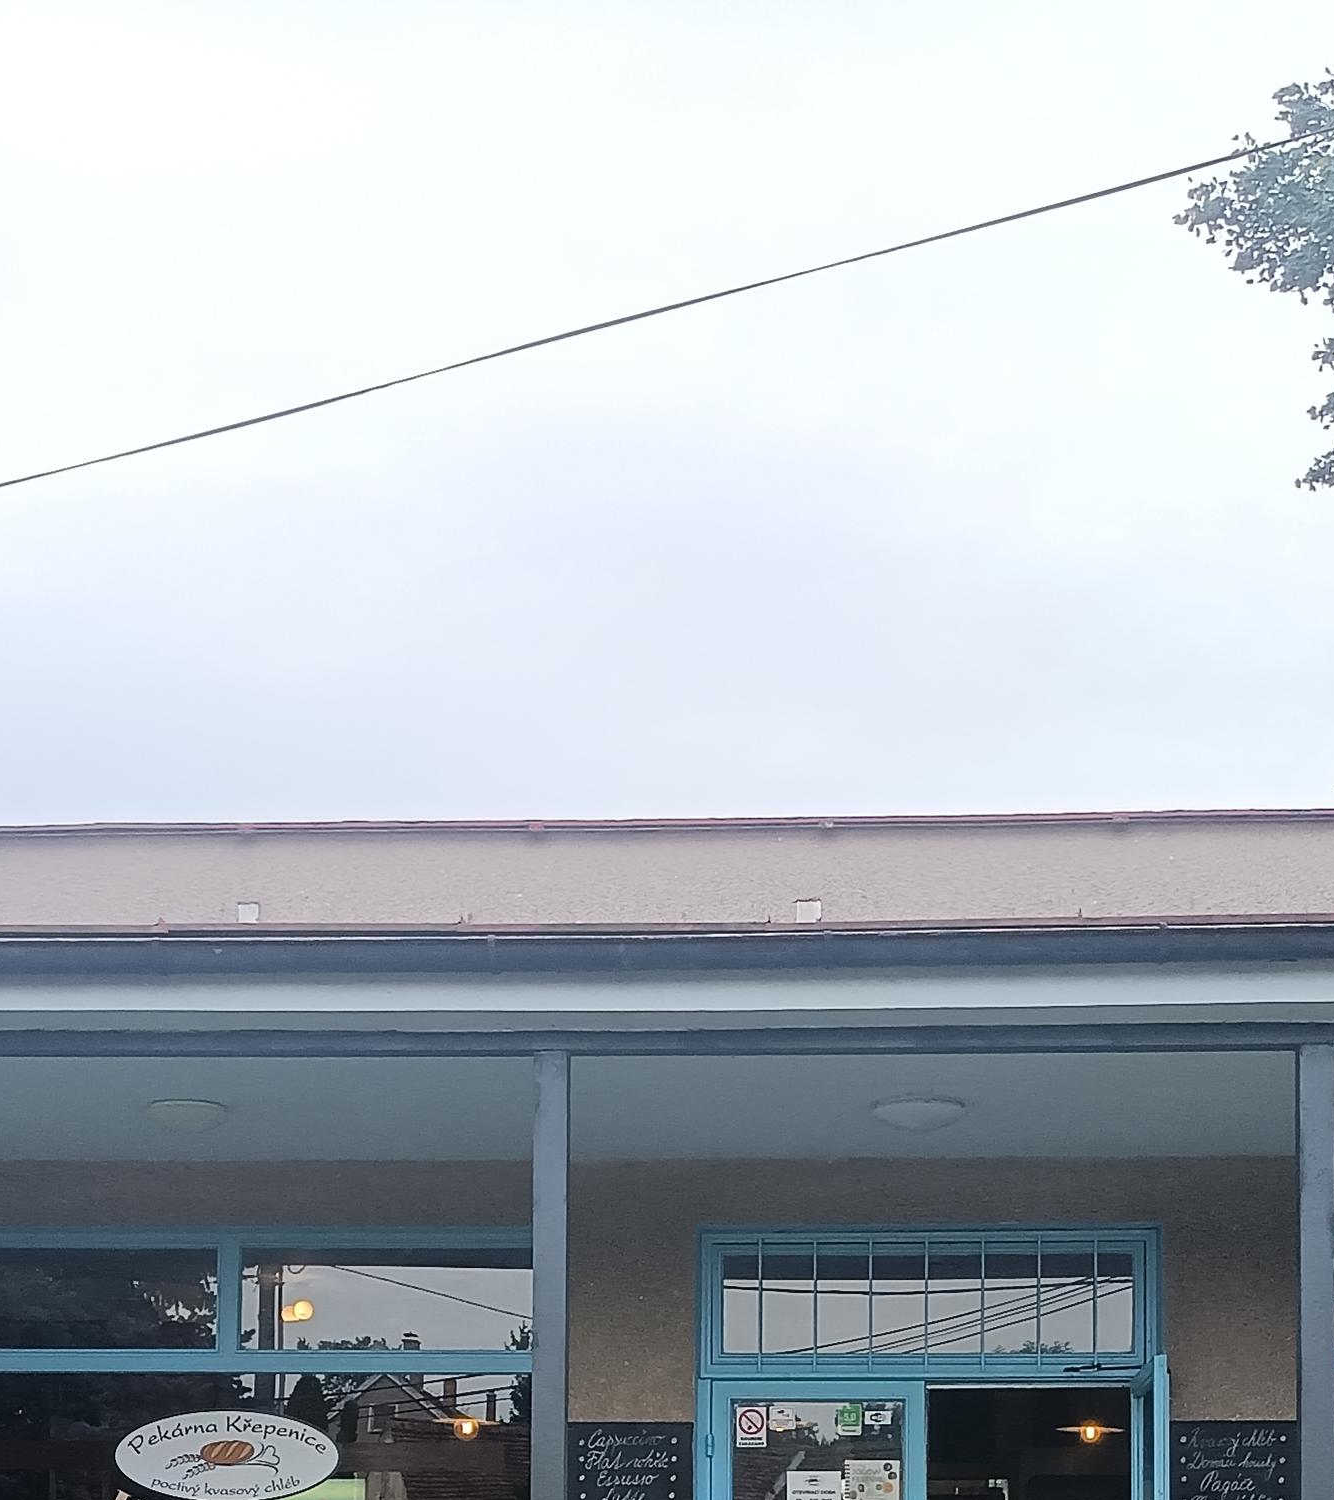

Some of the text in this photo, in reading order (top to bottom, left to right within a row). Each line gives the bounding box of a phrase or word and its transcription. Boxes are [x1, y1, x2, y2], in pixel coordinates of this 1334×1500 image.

[127, 1416, 327, 1455] Pekárna Křepenice
[151, 1475, 301, 1497] poctivý kvasový chléb
